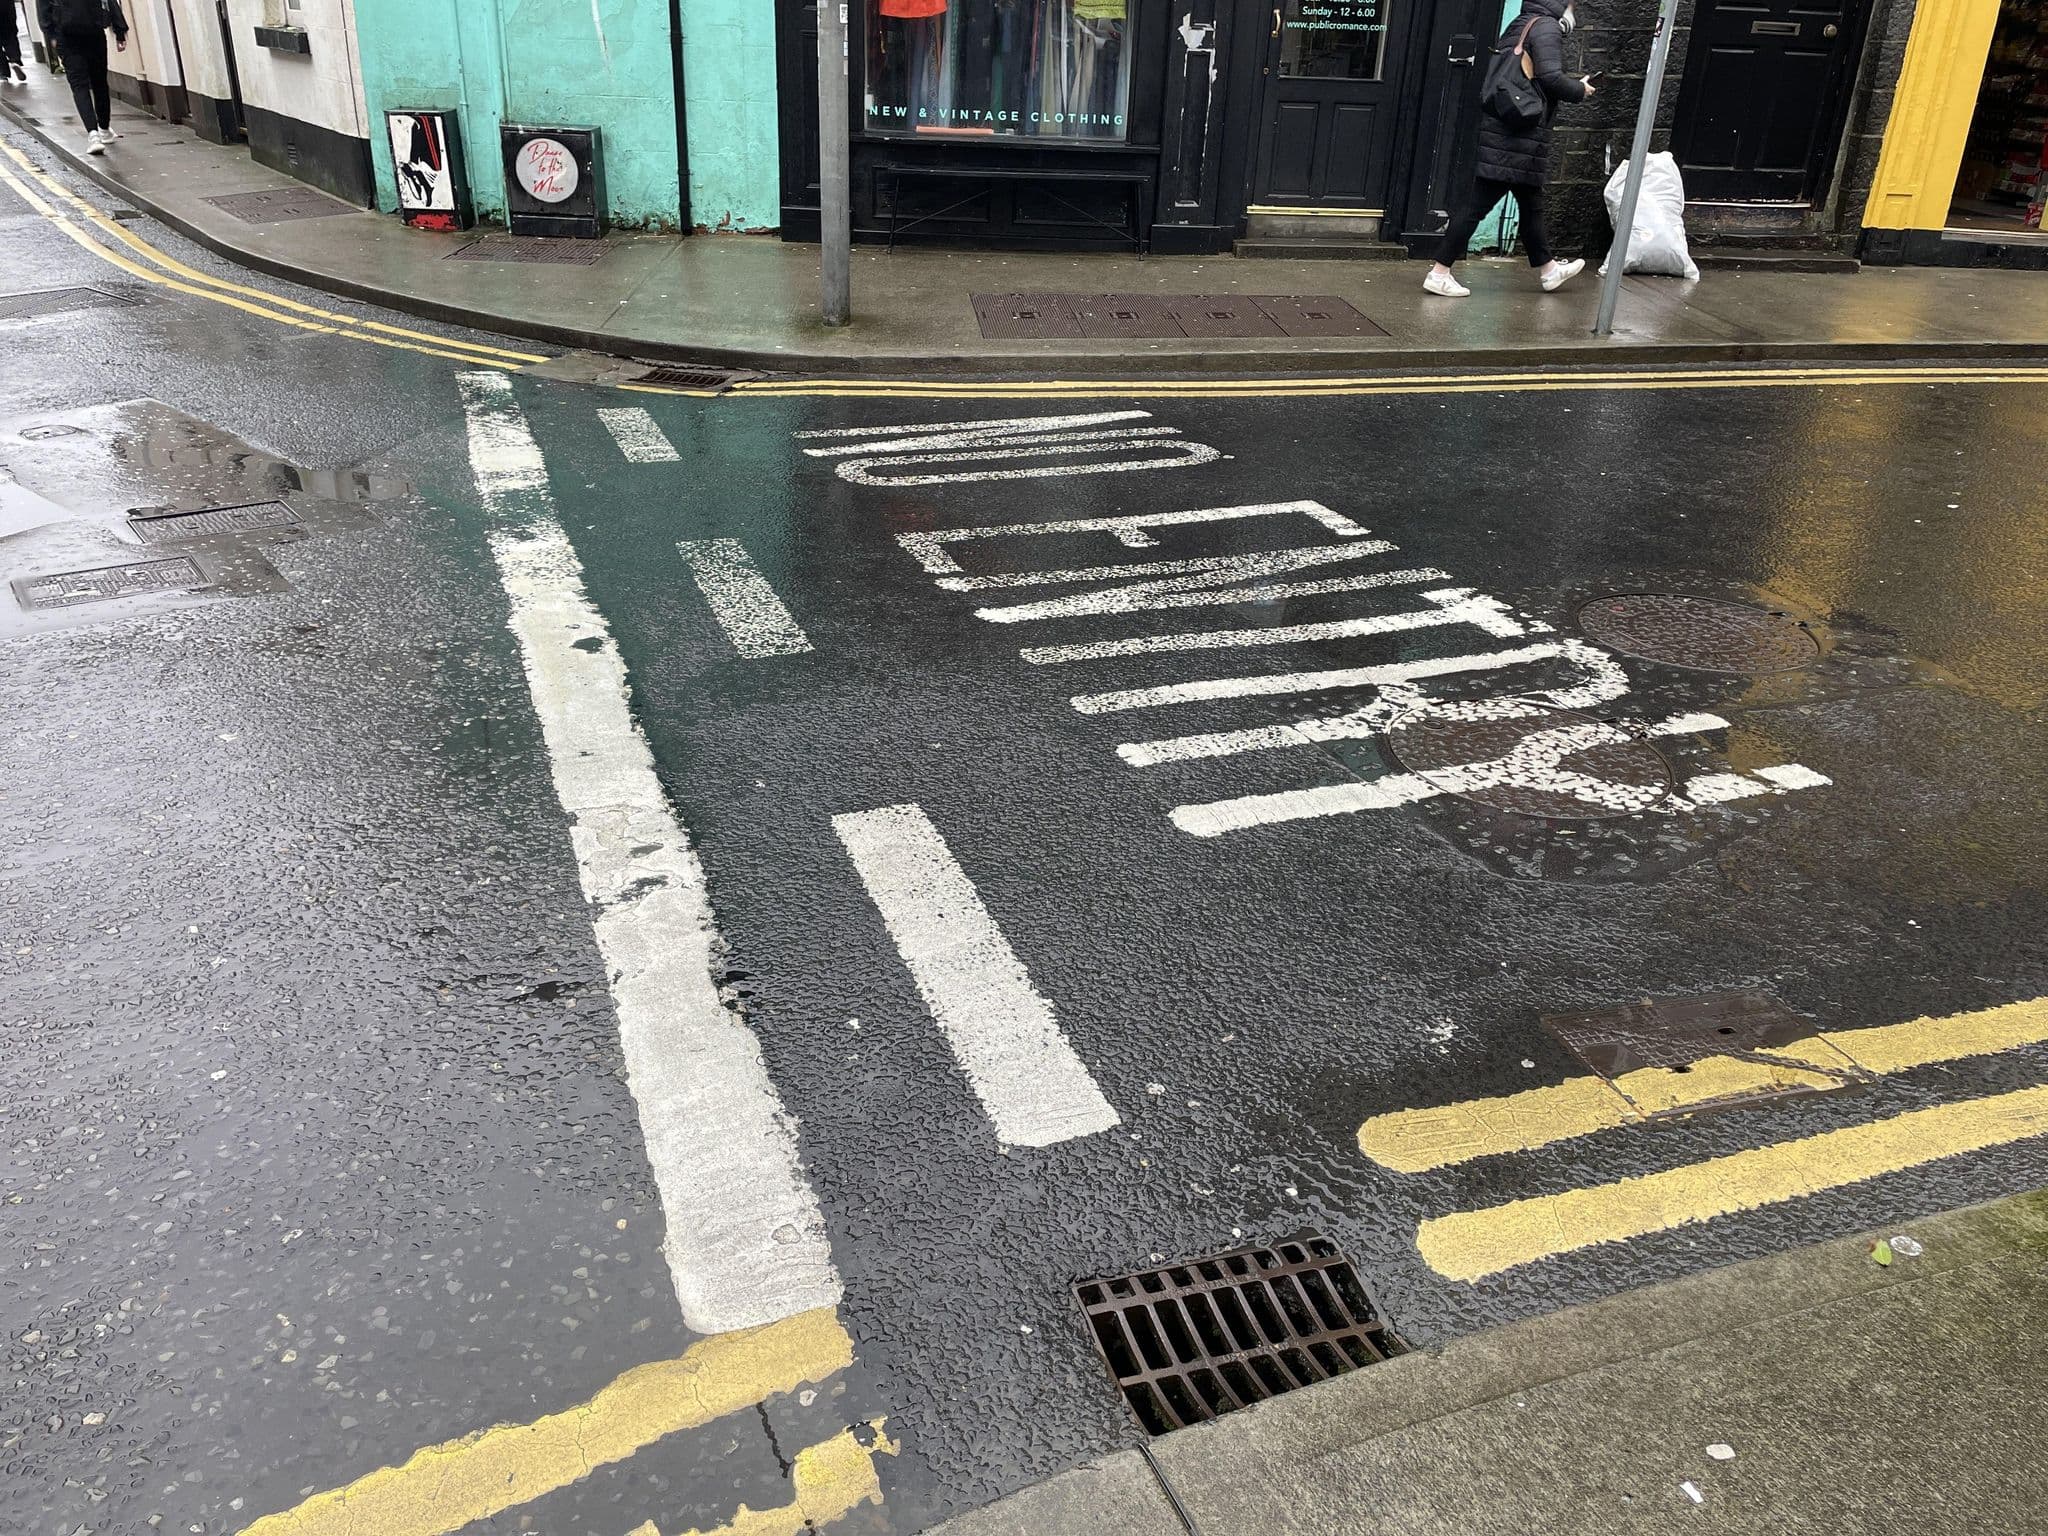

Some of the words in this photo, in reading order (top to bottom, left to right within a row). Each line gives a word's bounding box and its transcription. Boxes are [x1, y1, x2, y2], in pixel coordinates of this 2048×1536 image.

[1302, 5, 1333, 18] Sunday
[1340, 7, 1351, 16] 12
[1356, 8, 1376, 17] 6.00
[1286, 20, 1388, 31] www.publicromance.com
[869, 106, 908, 117] NEW
[918, 107, 927, 118] &
[939, 109, 1019, 121] VINTAGE
[1030, 111, 1123, 125] CLOTHING
[538, 158, 546, 174] to
[548, 158, 563, 175] the
[533, 175, 564, 196] Moon
[796, 408, 1224, 486] NO
[895, 499, 1833, 838] ENTRY
